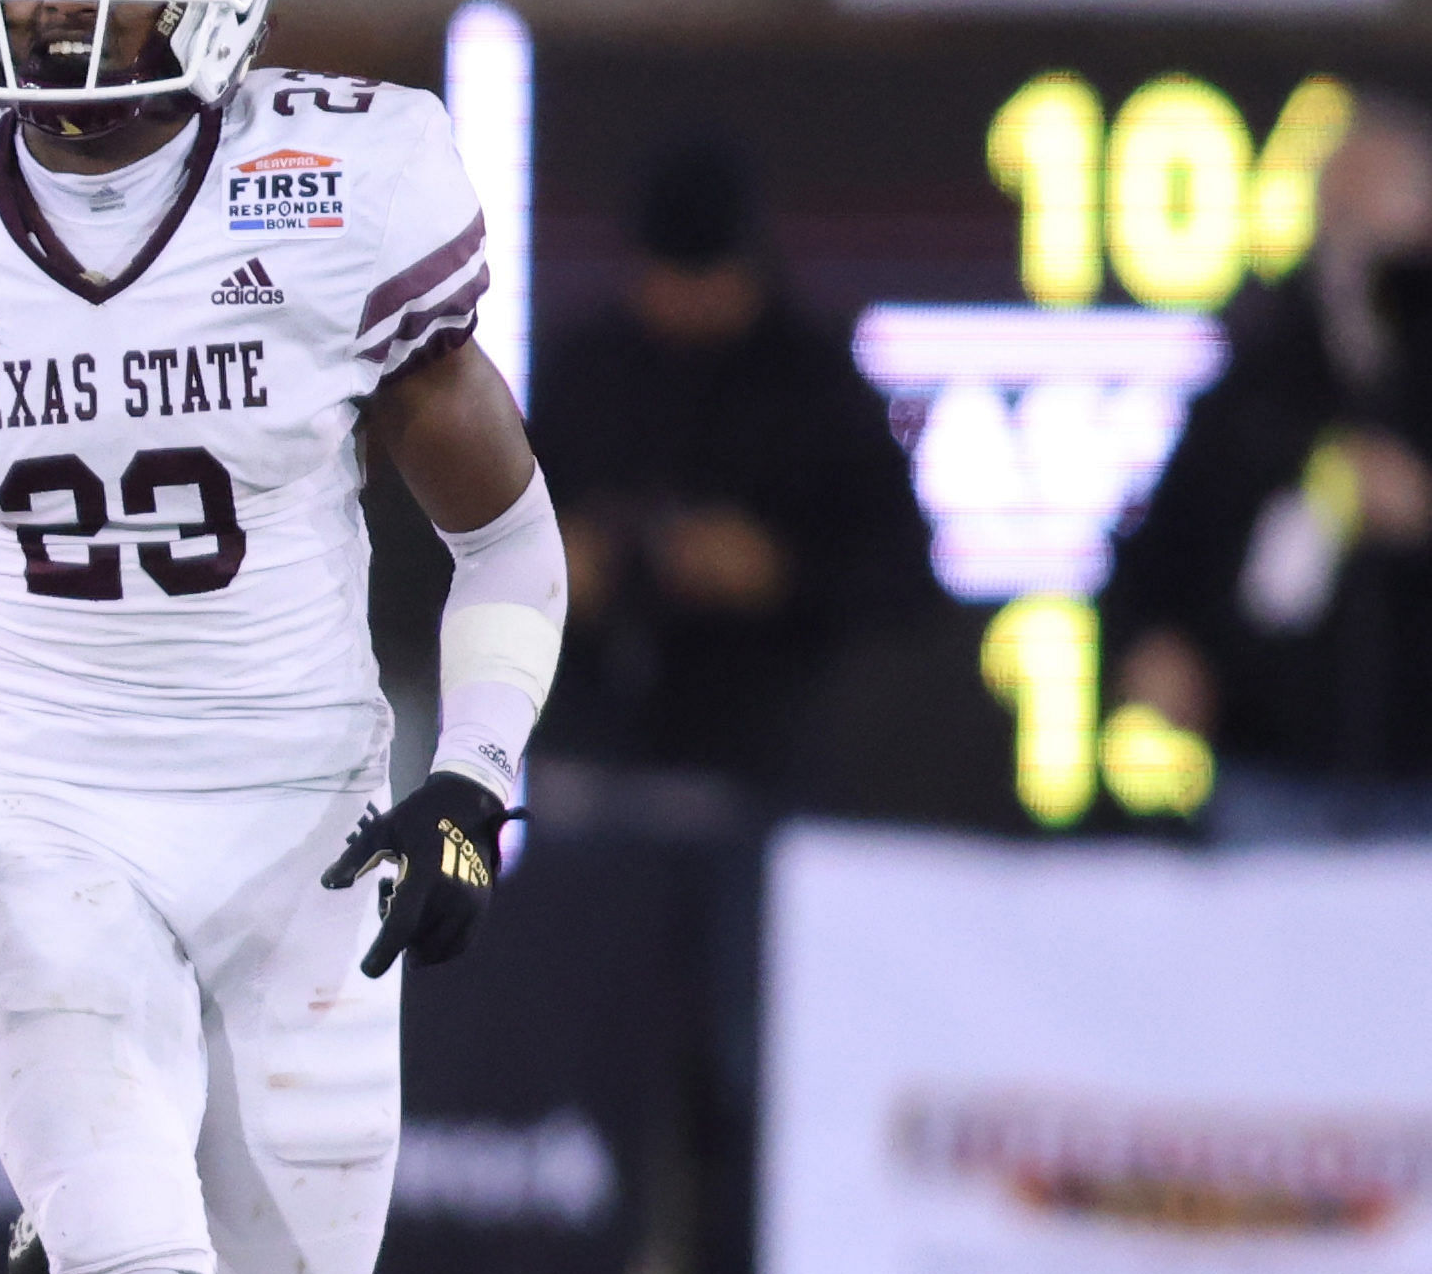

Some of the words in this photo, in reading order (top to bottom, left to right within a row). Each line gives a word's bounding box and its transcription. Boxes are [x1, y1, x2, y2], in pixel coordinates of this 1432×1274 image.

[229, 201, 343, 217] RESPONDER
[266, 218, 305, 230] BOWL
[211, 286, 285, 305] adidas
[122, 340, 268, 418] STATE
[478, 742, 514, 782] adida
